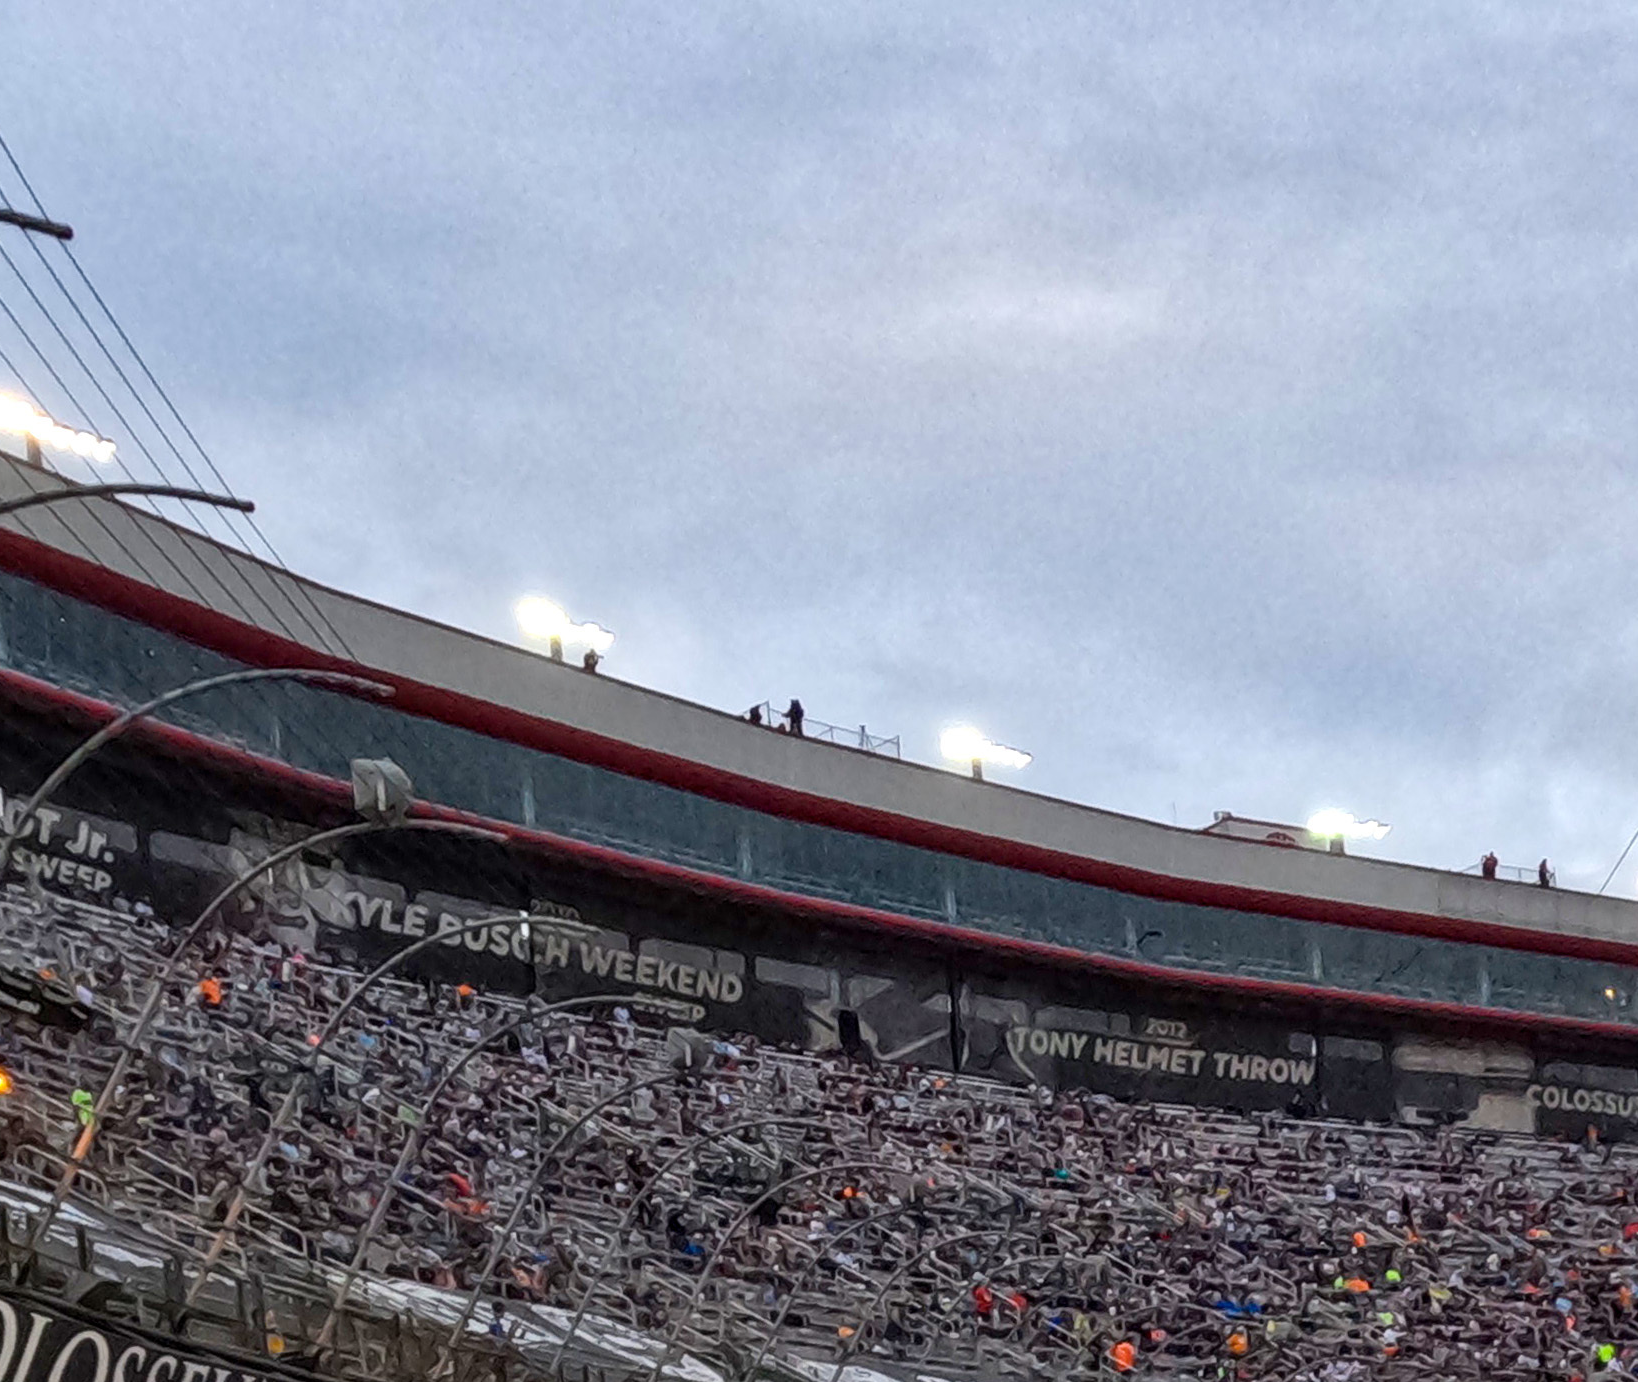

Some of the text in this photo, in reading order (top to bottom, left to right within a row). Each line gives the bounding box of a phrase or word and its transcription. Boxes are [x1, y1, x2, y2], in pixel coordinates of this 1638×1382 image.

[65, 820, 115, 863] Jr.
[579, 941, 743, 1002] WEEKEND
[1011, 1027, 1315, 1086] TONY HELMET THROW
